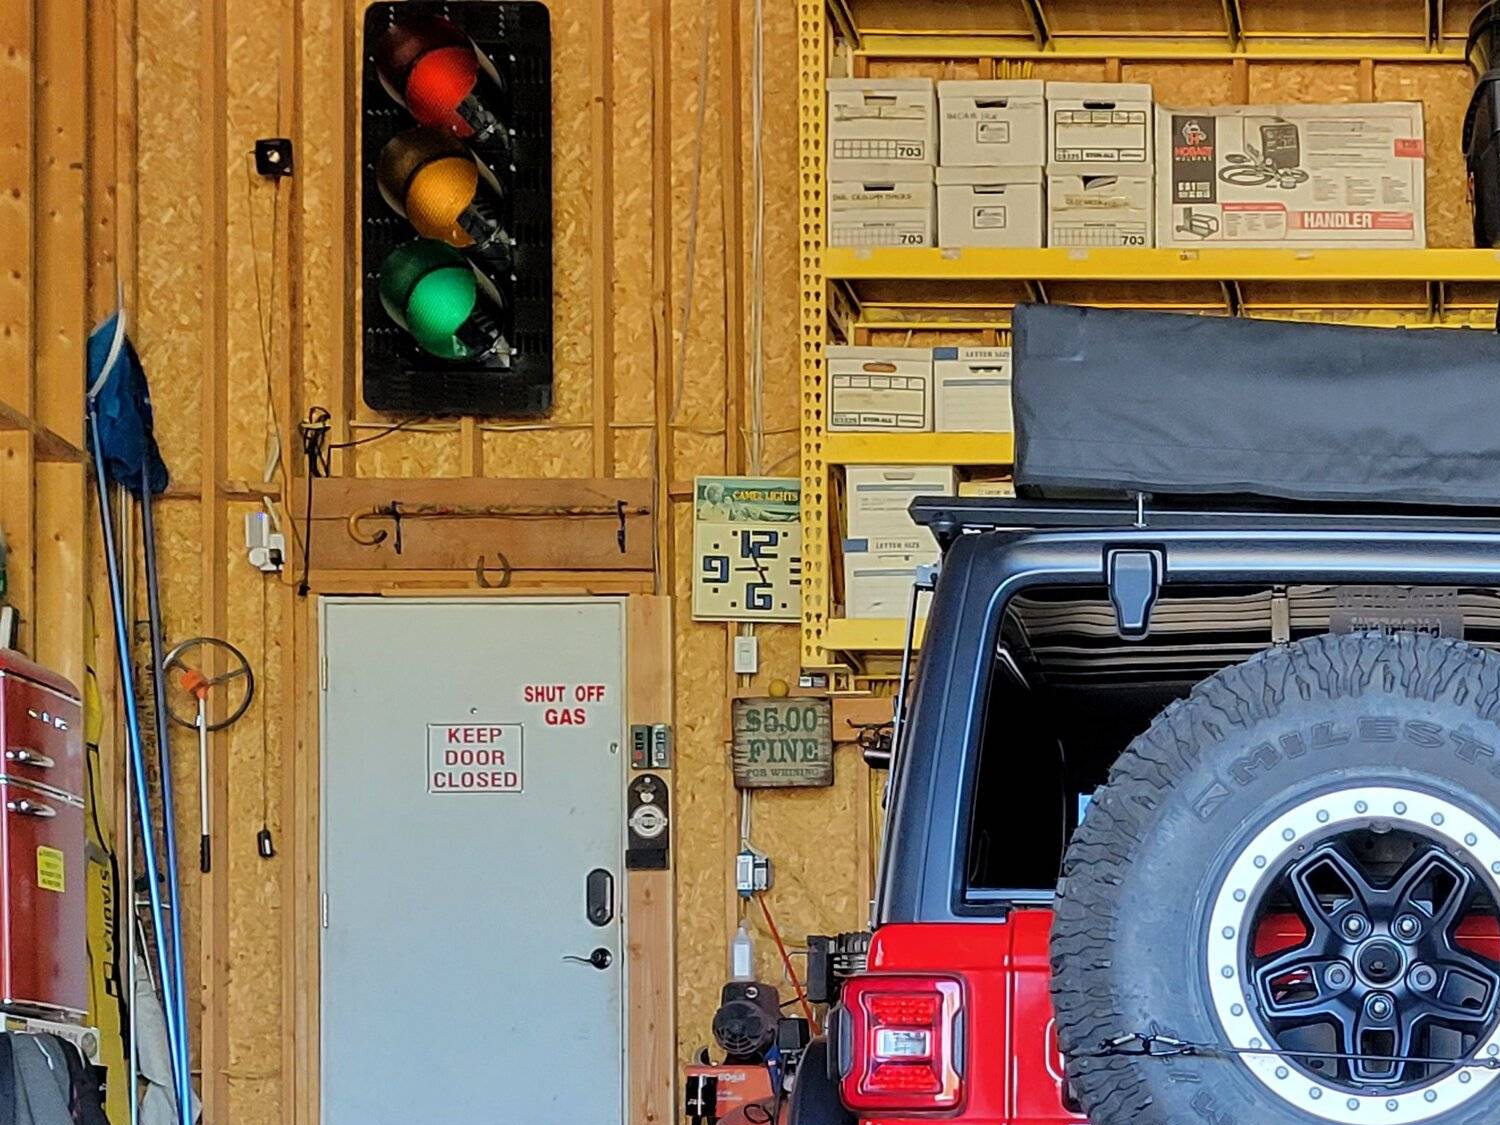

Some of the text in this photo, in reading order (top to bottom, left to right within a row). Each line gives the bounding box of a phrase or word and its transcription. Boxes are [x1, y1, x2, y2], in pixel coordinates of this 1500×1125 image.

[899, 147, 921, 157] 703
[1174, 146, 1213, 156] HOBART
[1303, 212, 1373, 229] HANDLER
[900, 235, 924, 245] 703
[1122, 236, 1145, 245] 703
[966, 350, 993, 358] LETTER
[734, 490, 798, 501] CAMEL LIGHTS
[741, 530, 778, 558] 12
[875, 541, 920, 549] LETTER SIZE
[703, 556, 729, 583] 9
[746, 583, 773, 610] 6
[524, 686, 605, 702] SHUT OFF
[545, 709, 586, 725] GAS
[745, 707, 818, 732] $5.00
[448, 728, 502, 743] KEEP
[445, 750, 504, 766] DOOR
[747, 739, 819, 763] FINE
[434, 772, 517, 788] CLOSED
[746, 768, 820, 778] FOR WHINING
[100, 869, 113, 953] STABILA
